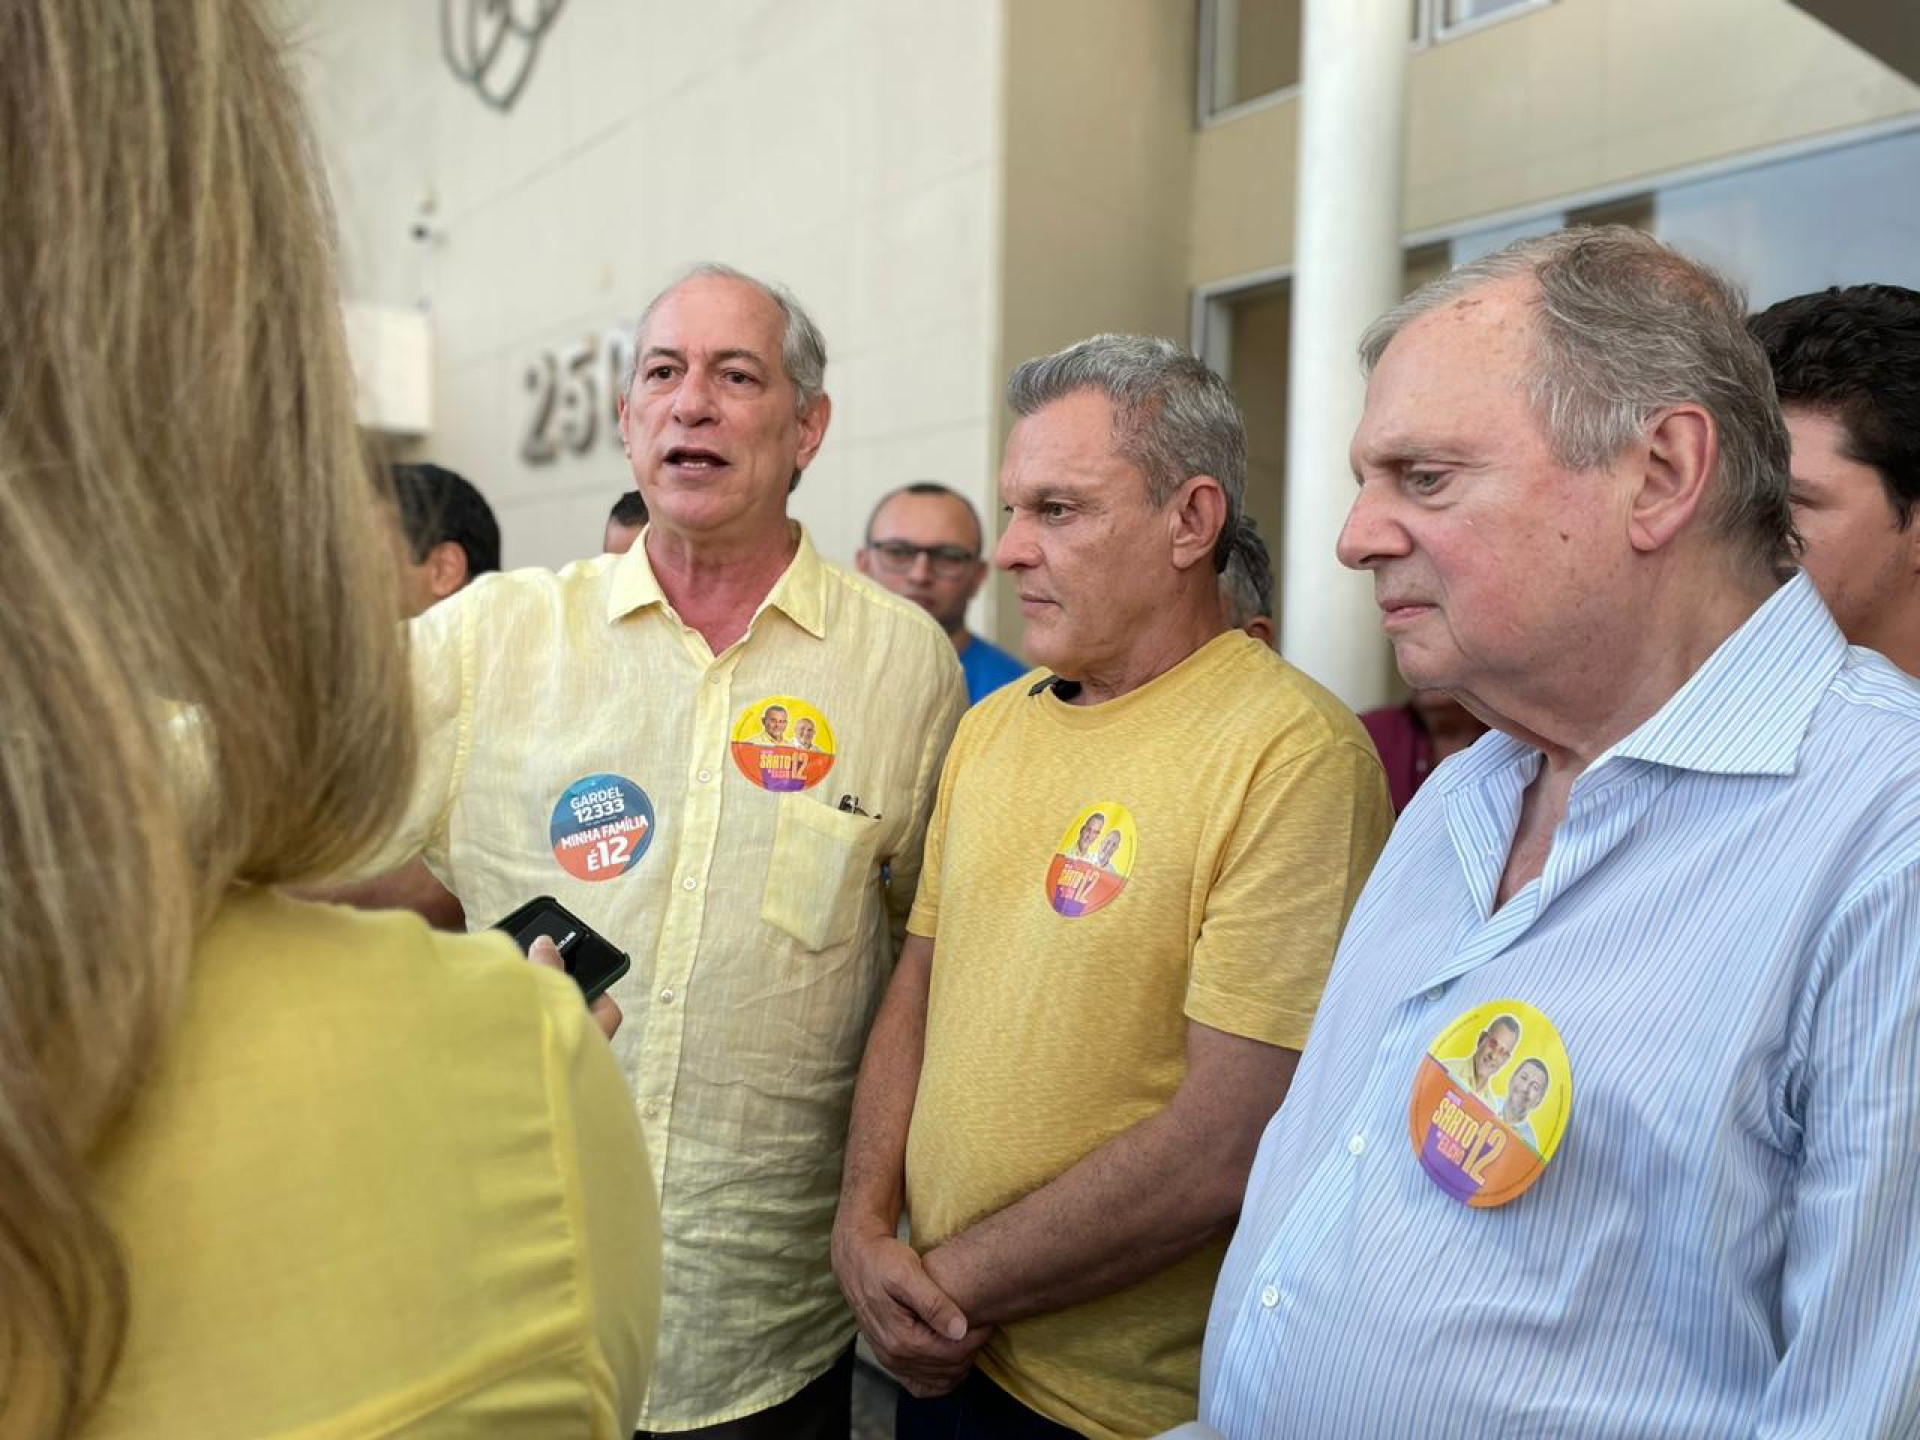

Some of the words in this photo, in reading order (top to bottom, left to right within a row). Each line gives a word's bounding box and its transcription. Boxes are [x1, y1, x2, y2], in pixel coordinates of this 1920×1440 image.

[570, 786, 624, 809] GARDEL
[575, 798, 624, 823] 12333
[560, 828, 600, 850] MINHA
[601, 815, 648, 838] FAMÍLIA
[1431, 1097, 1479, 1149] SARTO
[1461, 1120, 1507, 1186] 12
